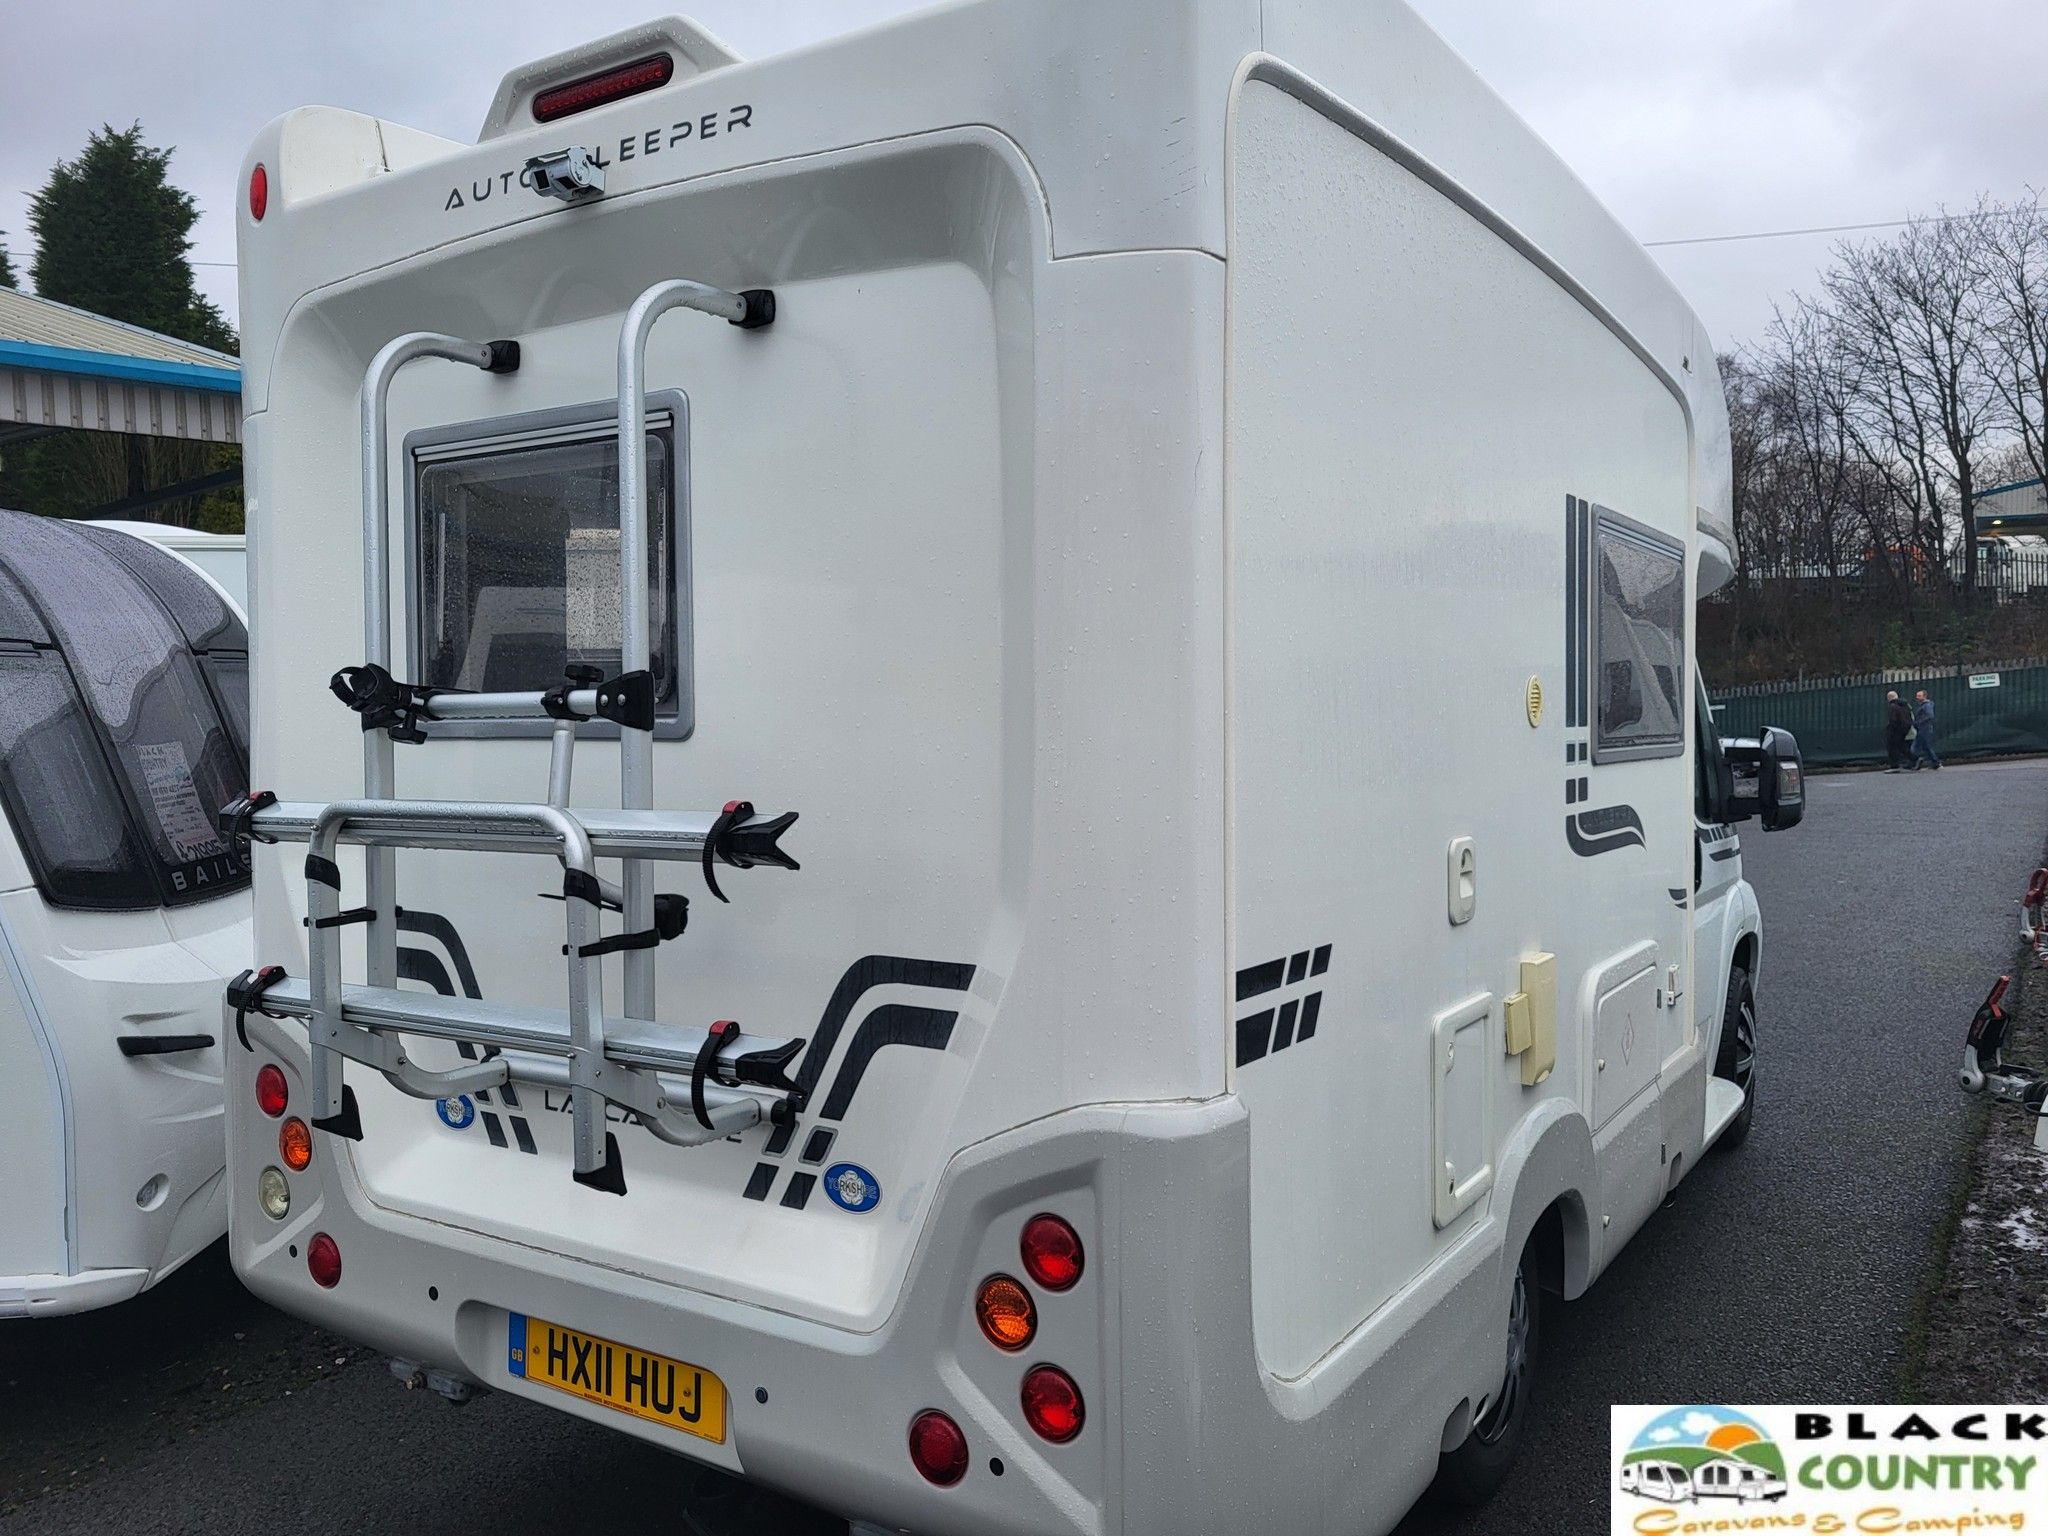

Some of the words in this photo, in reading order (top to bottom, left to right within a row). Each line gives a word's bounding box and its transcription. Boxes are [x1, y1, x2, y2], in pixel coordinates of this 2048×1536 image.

[826, 1176, 878, 1200] YORKSHIRE
[511, 1347, 523, 1362] GB
[547, 1327, 613, 1397] HX11
[625, 1352, 702, 1424] HUJ
